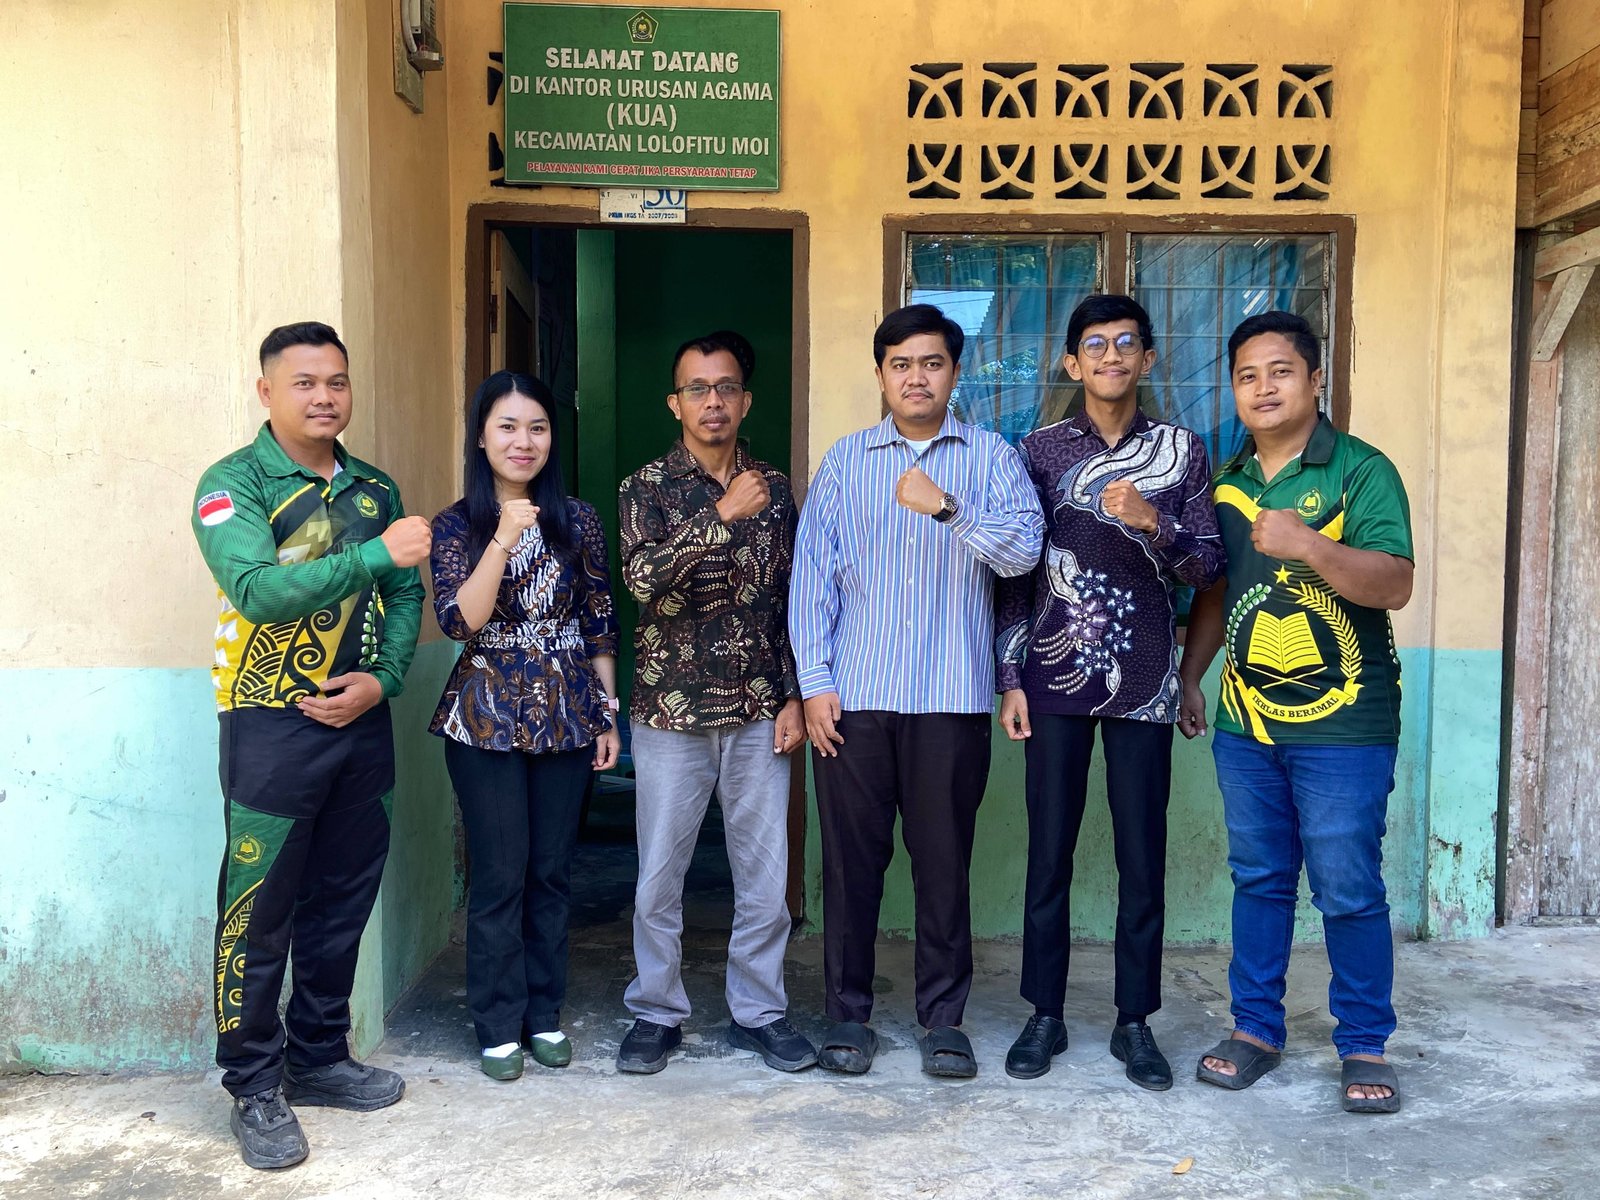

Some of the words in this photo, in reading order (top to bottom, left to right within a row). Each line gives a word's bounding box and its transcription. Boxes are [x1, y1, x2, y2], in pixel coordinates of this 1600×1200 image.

[545, 47, 645, 71] SELAMAT
[652, 50, 739, 73] DATANG
[510, 75, 529, 94] DI
[535, 77, 612, 97] KANTOR
[617, 79, 697, 99] URUSAN
[702, 81, 773, 101] AGAMA
[606, 103, 677, 132] (KUA)
[514, 130, 632, 153] KECAMATAN
[637, 134, 726, 155] LOLOFITU
[732, 137, 769, 156] MOI
[527, 162, 581, 174] PELAYANAN
[583, 164, 608, 175] KAMI
[610, 165, 640, 176] CEPAT
[640, 166, 660, 177] JIKA
[663, 167, 727, 178] PERSYARATAN
[728, 168, 757, 179] TETAP
[1252, 694, 1286, 717] IKHLAS
[1288, 697, 1340, 718] BERAMAL
